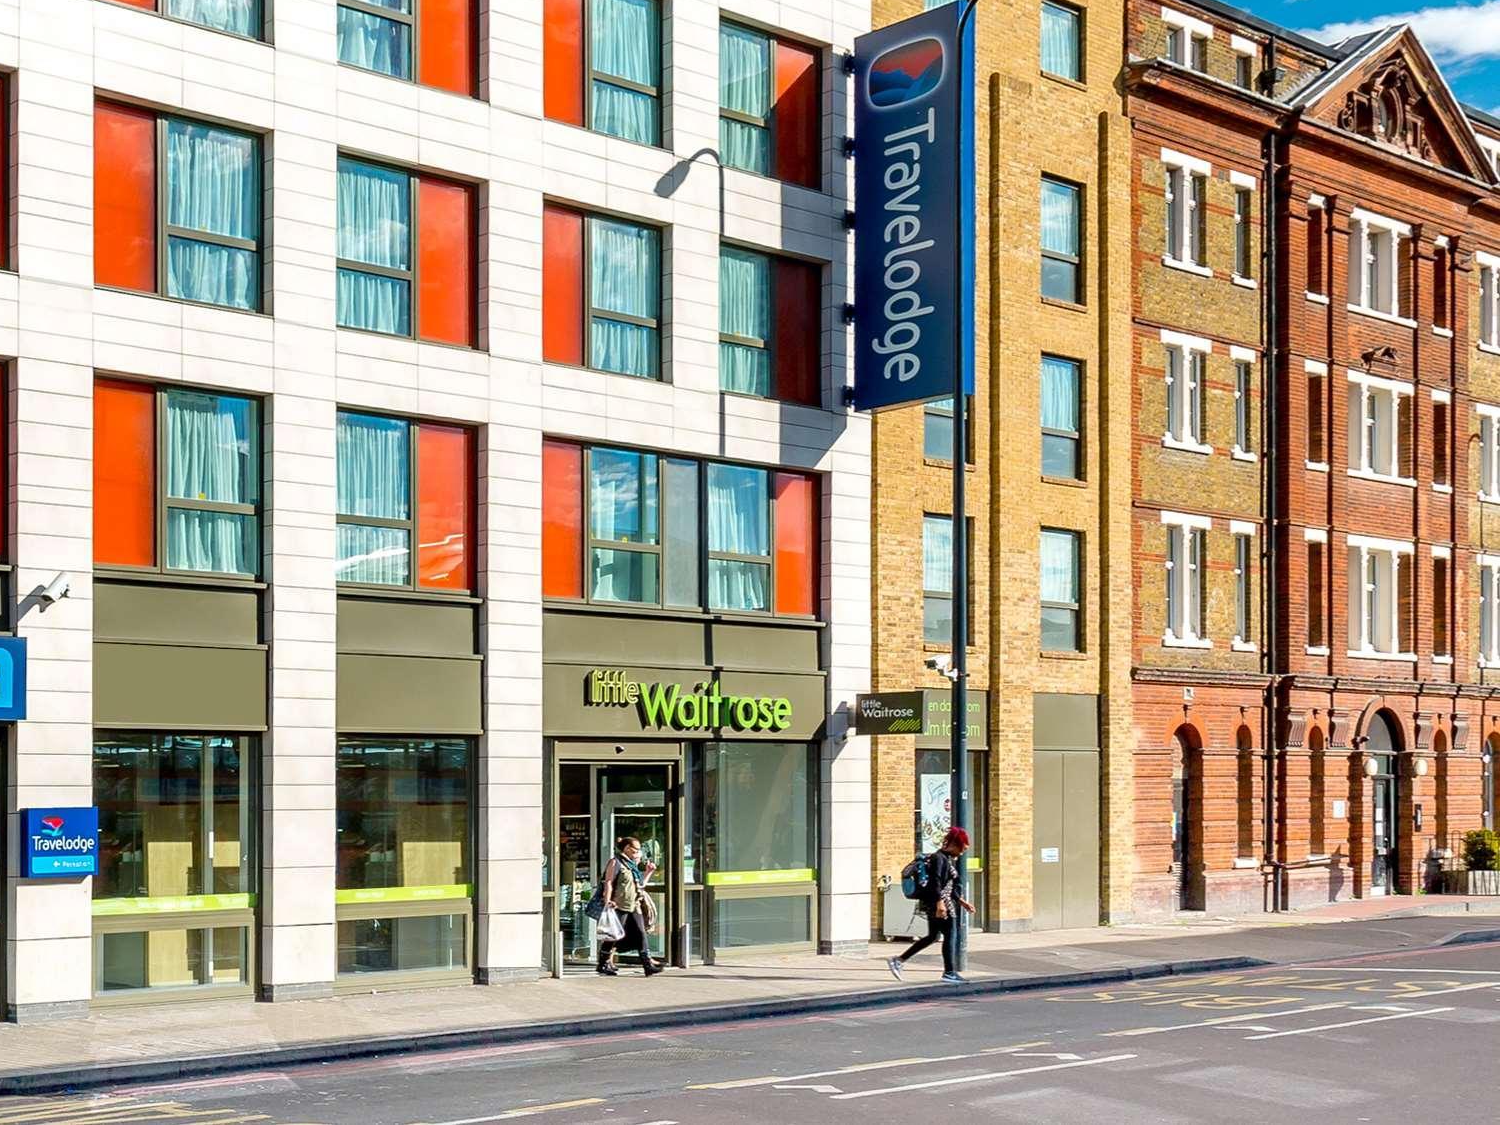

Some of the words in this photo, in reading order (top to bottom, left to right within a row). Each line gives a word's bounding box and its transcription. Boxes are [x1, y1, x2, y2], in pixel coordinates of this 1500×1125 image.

[872, 107, 935, 382] Travelodge
[591, 669, 640, 704] little
[639, 681, 792, 729] Waitrose
[861, 699, 882, 709] little
[862, 707, 914, 718] Waitrose
[32, 835, 95, 853] Travelodge
